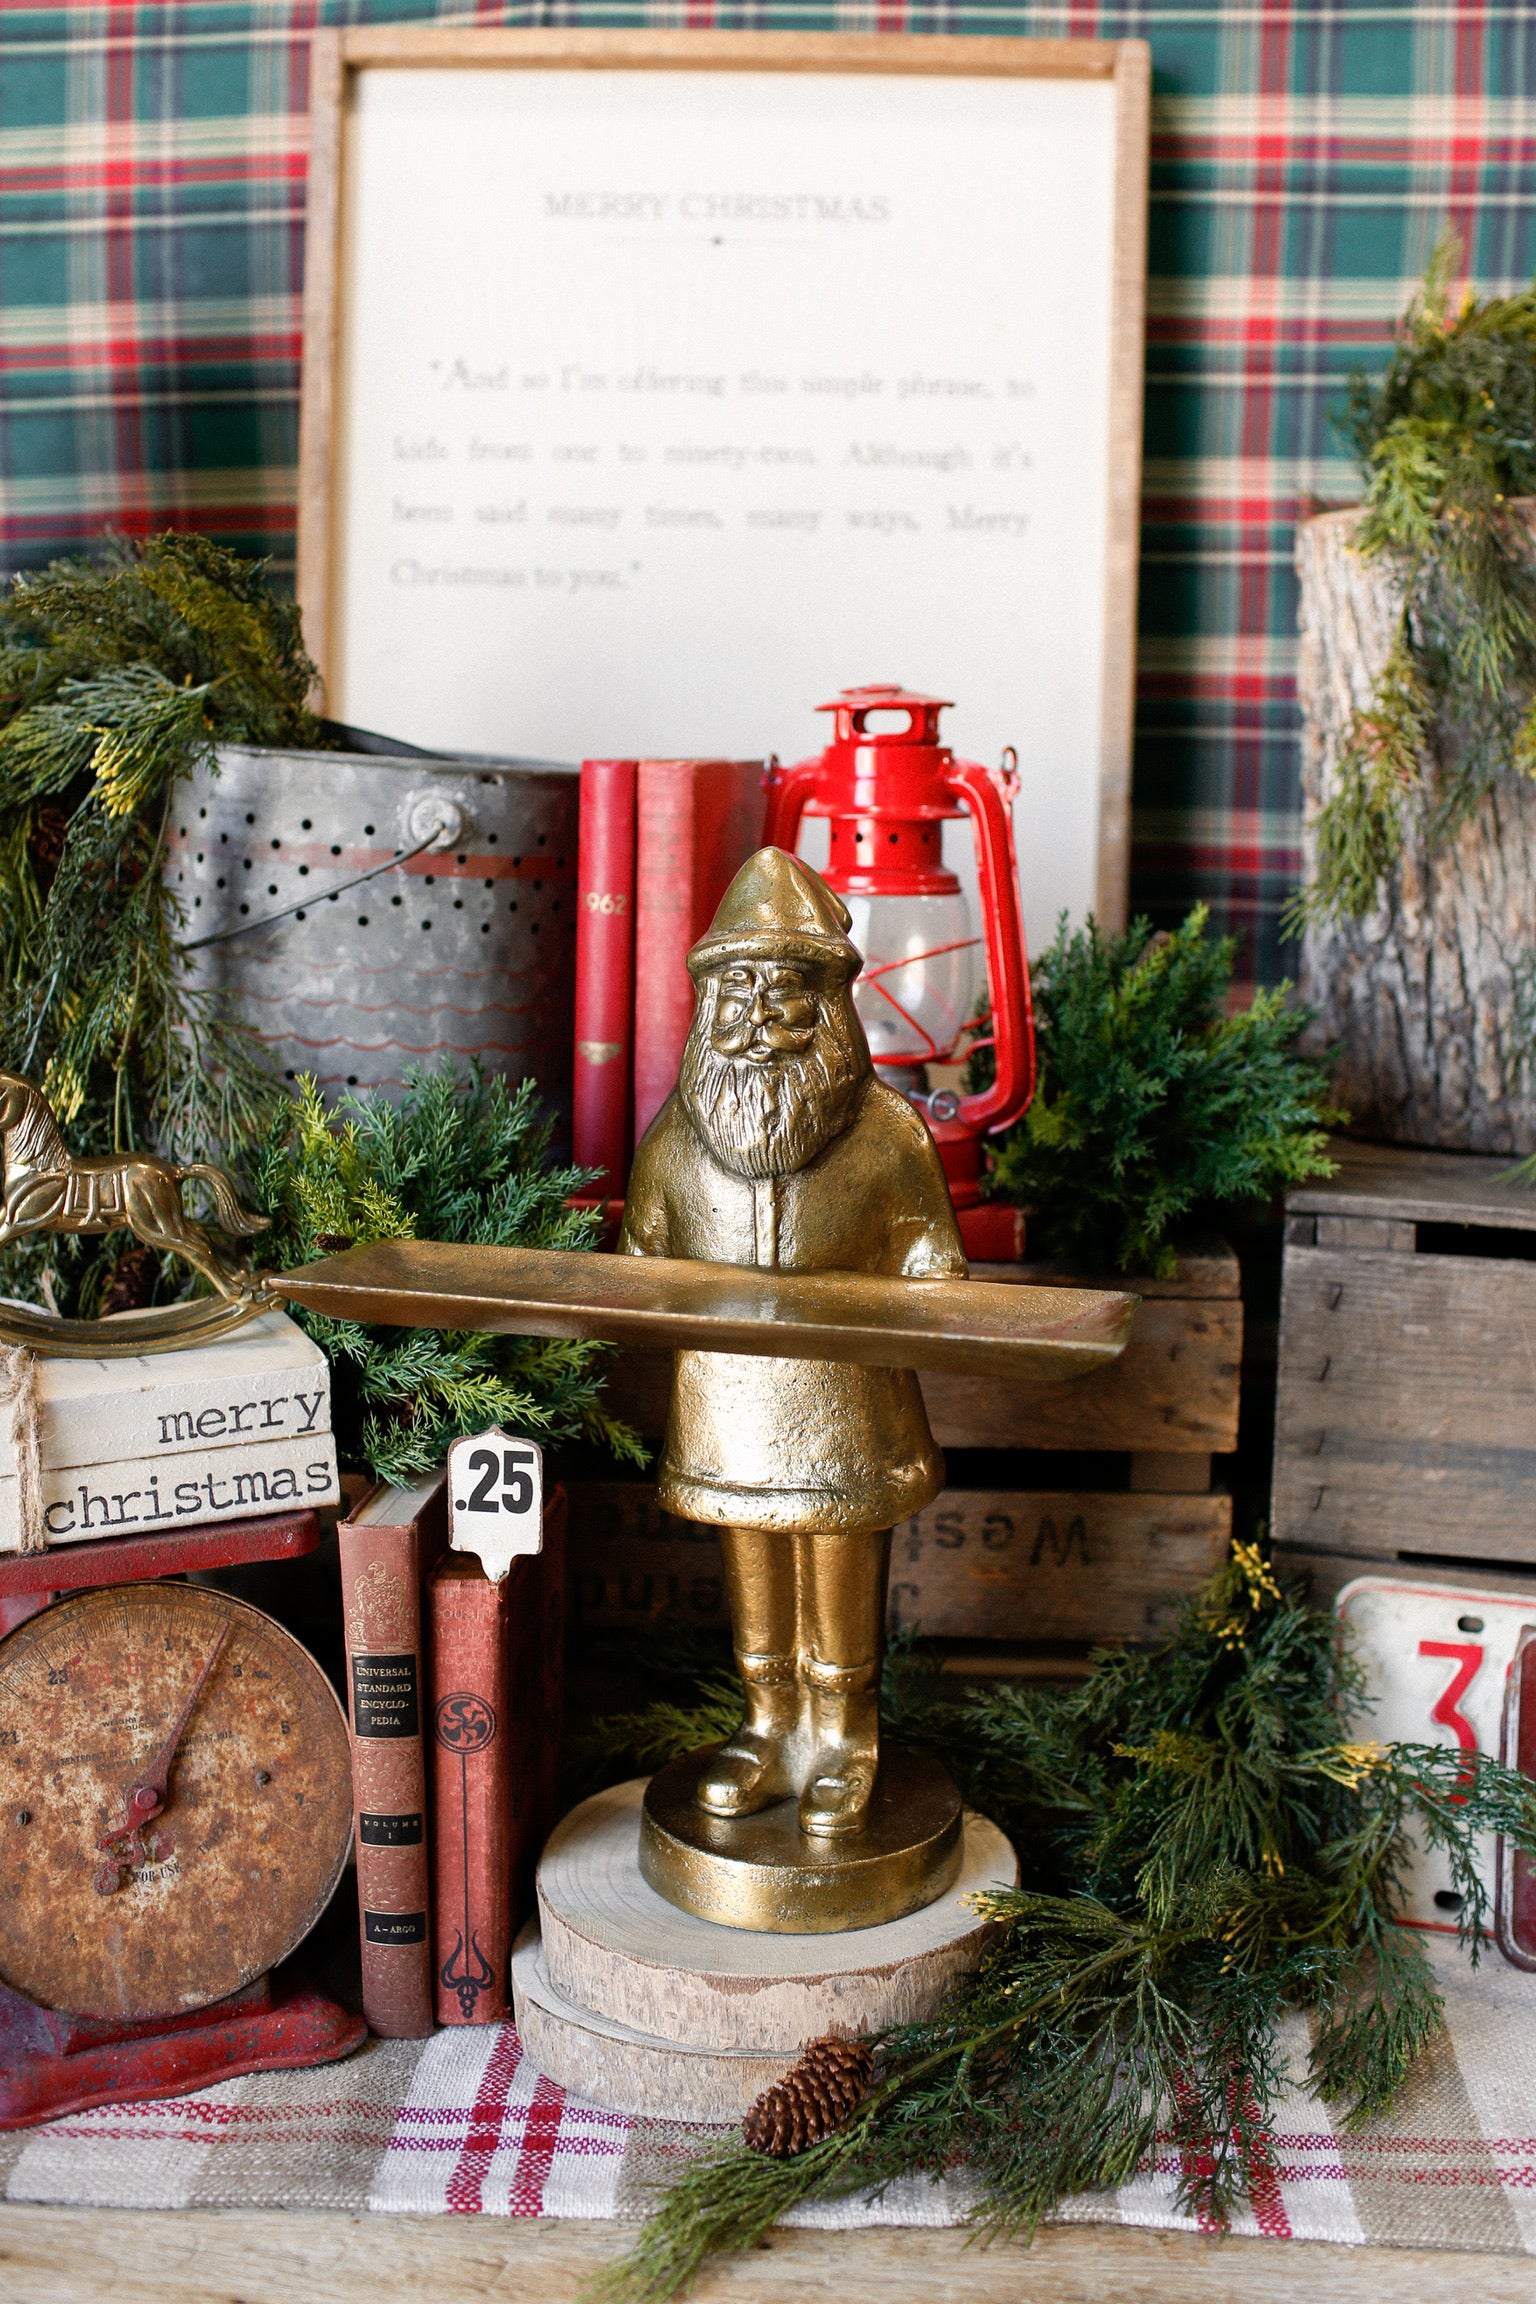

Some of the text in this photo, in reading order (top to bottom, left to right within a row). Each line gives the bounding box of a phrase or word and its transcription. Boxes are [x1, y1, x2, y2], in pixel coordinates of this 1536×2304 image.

[544, 192, 891, 223] MERRY CHRISTMAS
[520, 372, 549, 392] so
[561, 364, 608, 393] I'm
[617, 365, 727, 398] offering
[740, 368, 789, 395] this
[800, 369, 884, 401] simple
[897, 371, 993, 401] phrase,
[1006, 377, 1036, 399] to
[392, 435, 449, 463] kids
[468, 435, 532, 463] from
[552, 444, 600, 464] one
[618, 443, 648, 464] to
[843, 441, 973, 474] Although
[993, 442, 1035, 470] it's
[392, 497, 453, 524] been
[474, 499, 528, 526] said
[548, 506, 623, 532] many
[747, 509, 824, 534] many
[947, 503, 1031, 538] Merry
[389, 558, 528, 589] Christmas
[534, 566, 563, 589] to
[158, 1390, 326, 1444] merry
[455, 1449, 534, 1514] .25
[44, 1461, 333, 1535] christmas
[48, 1669, 68, 1685] 23
[356, 1667, 411, 1677] UNIVERSAL
[357, 1682, 412, 1693] STANDARD
[371, 1716, 400, 1725] PEDIA
[364, 1819, 418, 1828] VOLUME
